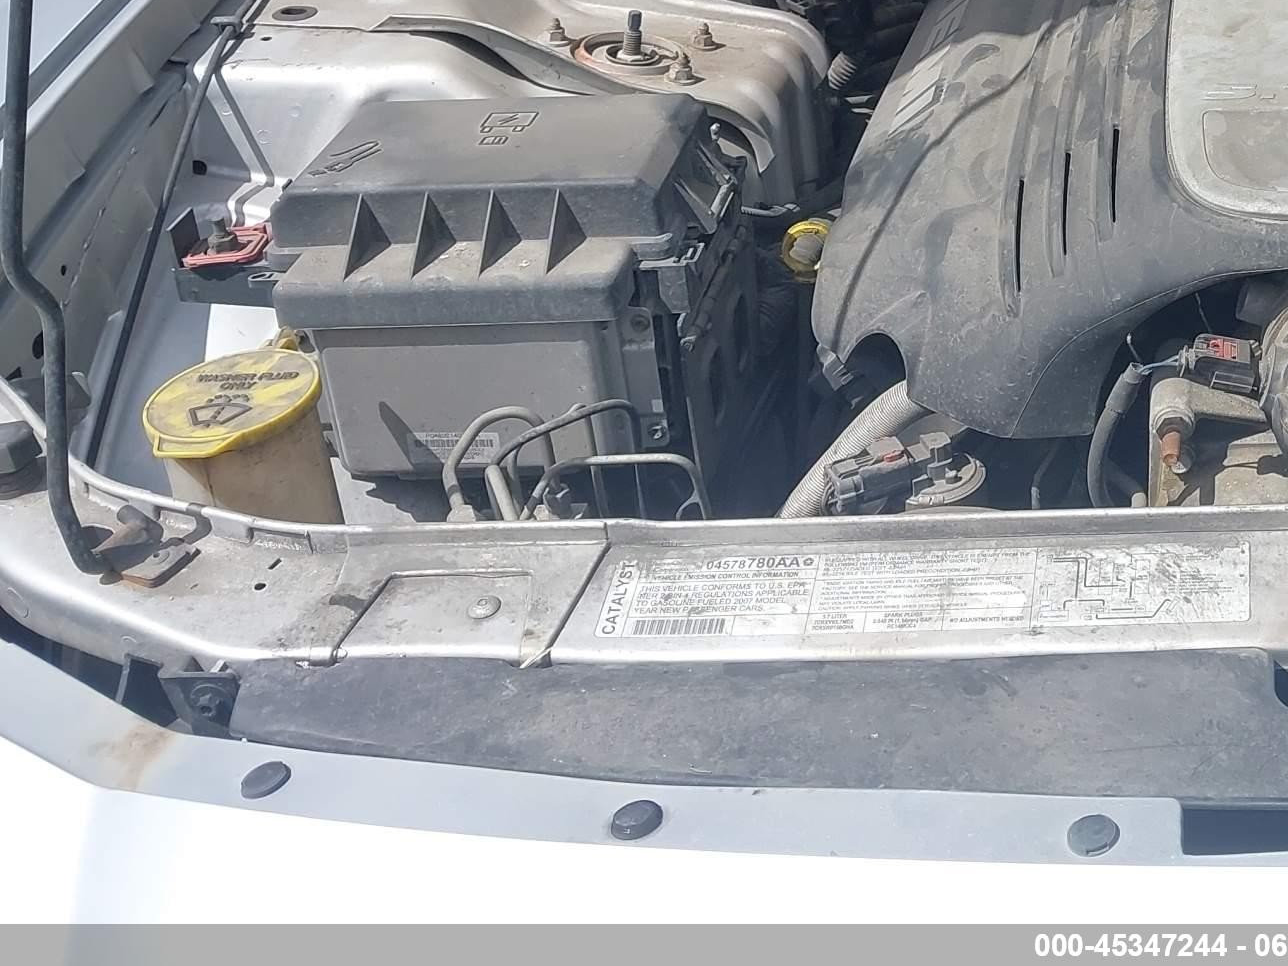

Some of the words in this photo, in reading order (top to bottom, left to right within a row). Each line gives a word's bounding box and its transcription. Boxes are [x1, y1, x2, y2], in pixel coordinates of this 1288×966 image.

[198, 373, 257, 383] WASHER
[258, 371, 300, 381] FLUID
[219, 381, 257, 391] ONLY
[706, 556, 800, 570] 04578780AA
[702, 583, 752, 592] CONFORMS
[754, 582, 766, 590] TO
[768, 582, 784, 590] U.S.
[601, 560, 636, 635] CATALYST
[691, 591, 754, 599] REGULATIONS
[754, 589, 809, 597] APPLICABLE
[650, 598, 696, 607] GASOLINE
[697, 598, 732, 606] FUELED
[754, 596, 786, 604] MODEL
[660, 606, 681, 614] NEW
[738, 604, 766, 612] CARS.
